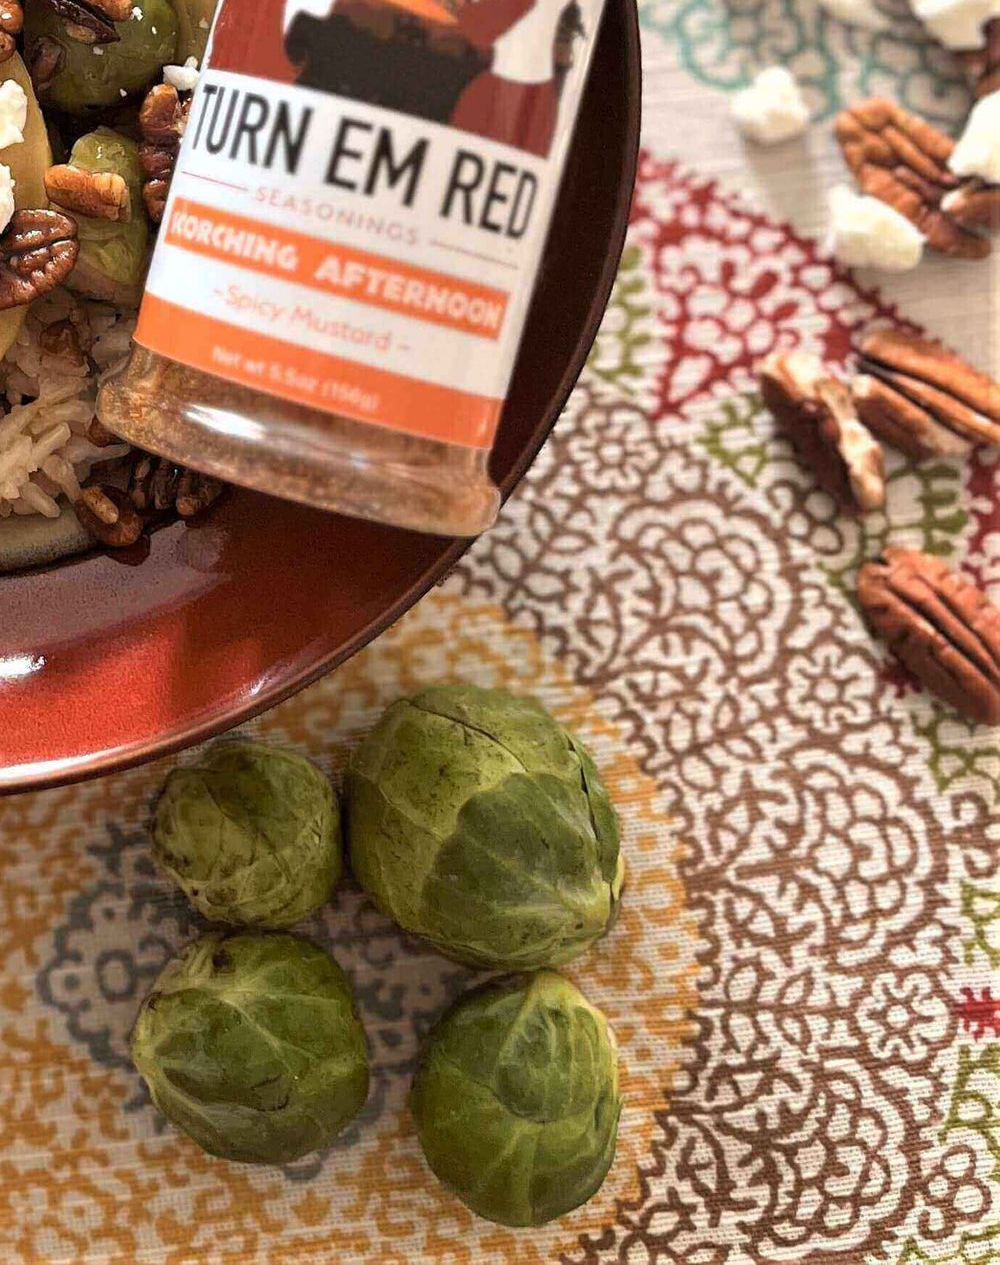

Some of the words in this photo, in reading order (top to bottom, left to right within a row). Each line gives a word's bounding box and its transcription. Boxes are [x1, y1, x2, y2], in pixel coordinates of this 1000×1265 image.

[192, 84, 315, 175] TURN
[325, 115, 429, 208] EM
[439, 148, 538, 240] RED
[256, 185, 419, 245] SEASONINGS
[225, 283, 285, 322] Spicy
[289, 304, 392, 351] Mustard
[314, 255, 503, 330] AFTERNOON
